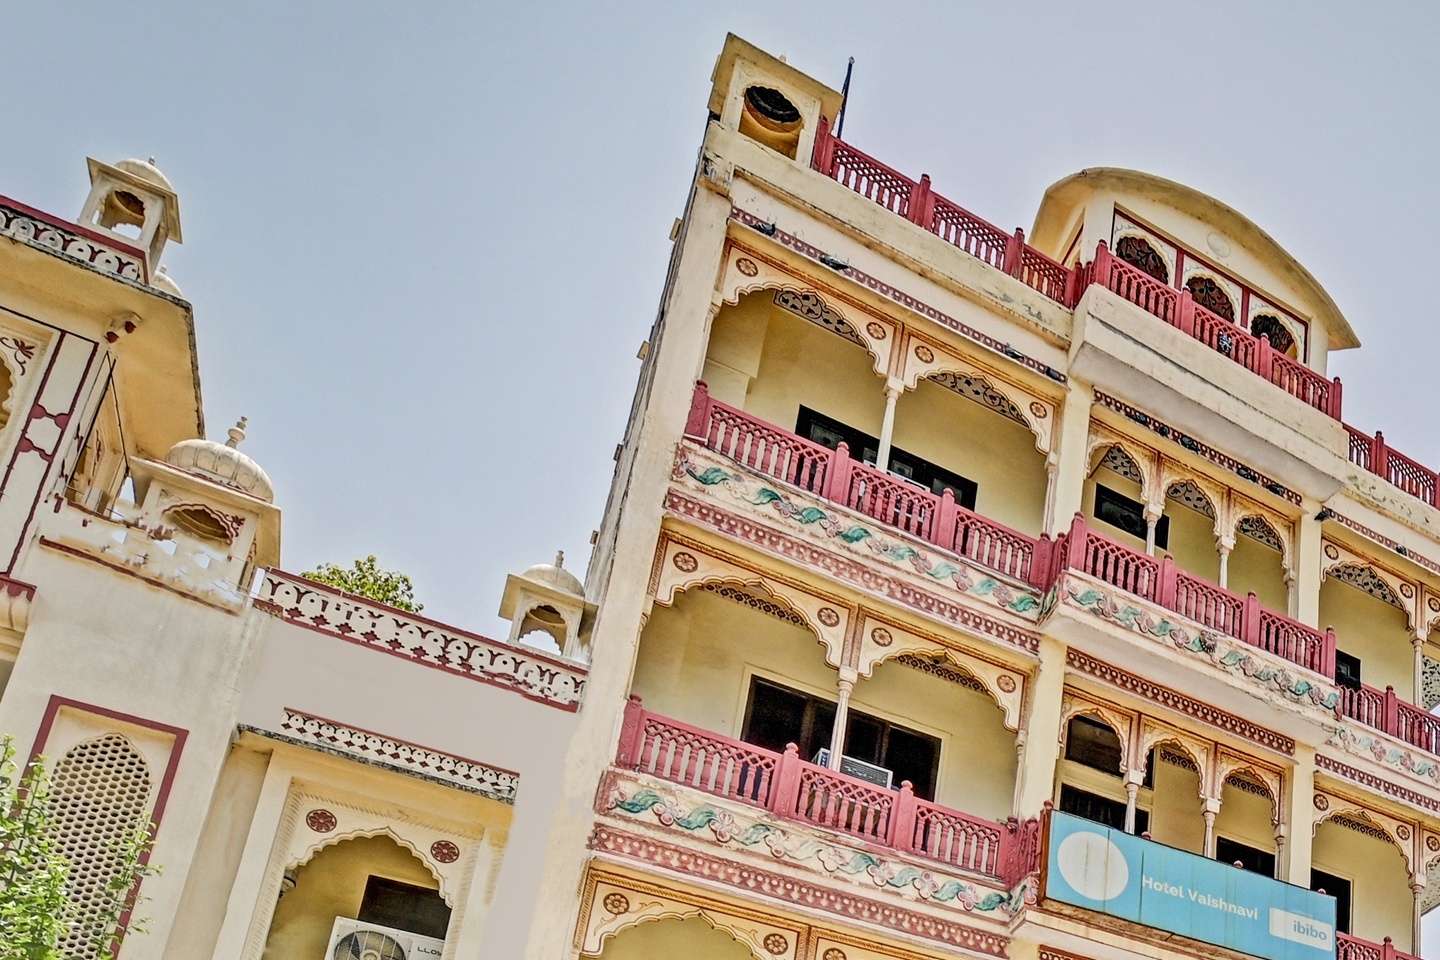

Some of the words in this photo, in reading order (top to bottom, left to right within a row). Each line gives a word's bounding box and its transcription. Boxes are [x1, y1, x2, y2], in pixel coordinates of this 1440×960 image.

[1141, 874, 1184, 898] Hotel
[1187, 888, 1258, 919] Vaishnavi
[1293, 919, 1327, 941] ibibo
